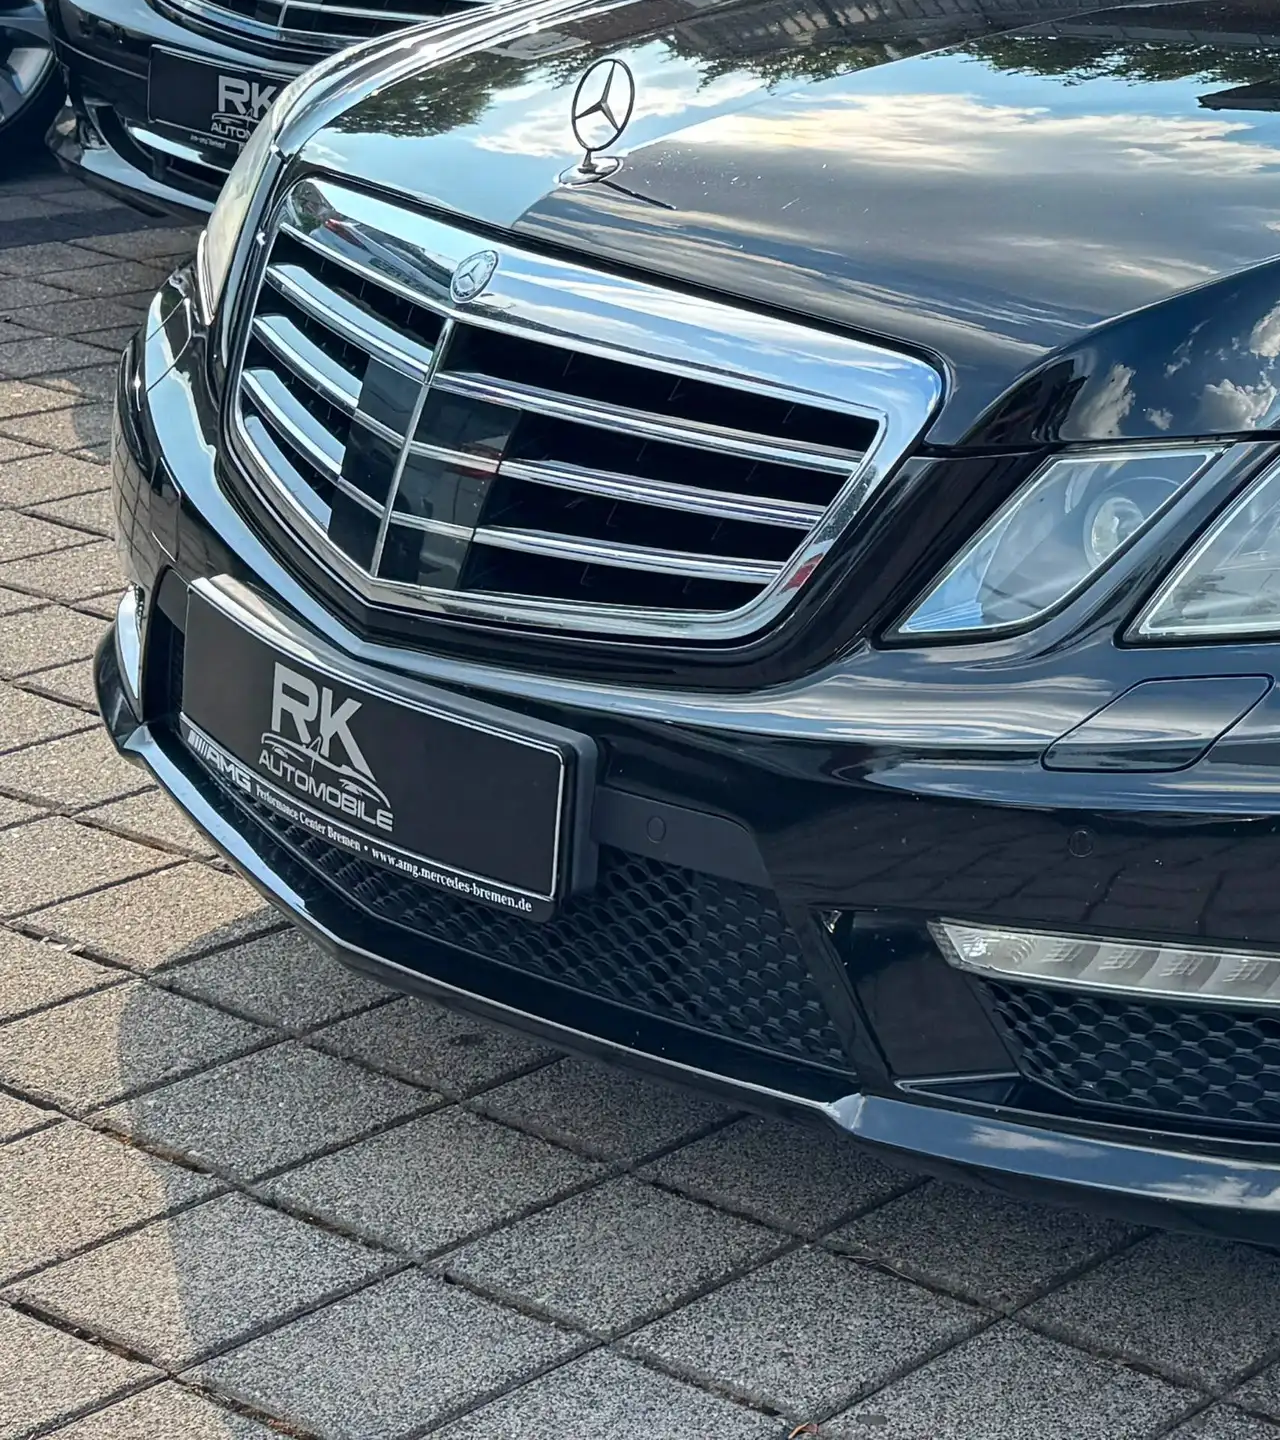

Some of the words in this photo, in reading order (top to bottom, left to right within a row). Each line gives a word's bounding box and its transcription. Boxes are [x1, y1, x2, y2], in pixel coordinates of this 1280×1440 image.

[218, 75, 277, 119] RK
[271, 661, 378, 782] RK
[206, 746, 251, 792] AMG
[256, 783, 298, 821] Performance
[300, 813, 326, 835] Center
[327, 825, 361, 852] Bremen
[372, 847, 533, 913] www.amg.mercedes-bremen.de
[259, 749, 394, 832] AUTOMOBILE
